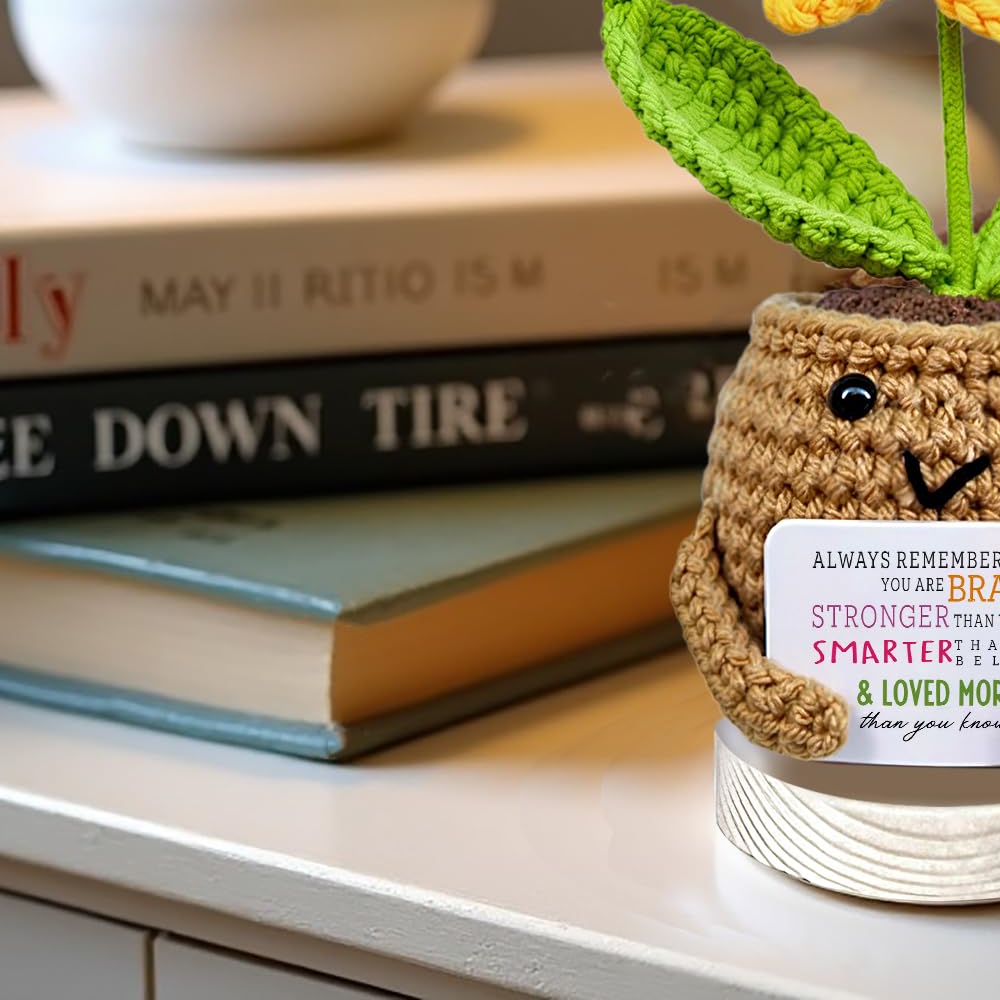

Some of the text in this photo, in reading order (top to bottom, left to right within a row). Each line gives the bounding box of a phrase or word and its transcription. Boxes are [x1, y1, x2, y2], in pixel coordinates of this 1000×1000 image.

[139, 276, 234, 318] MAY
[93, 394, 322, 472] DOWN
[360, 377, 528, 451] TIRE
[813, 551, 890, 569] ALWAYS
[881, 577, 911, 592] YOU
[915, 577, 944, 592] ARE
[811, 604, 949, 629] STRONGER
[953, 614, 994, 628] THAN
[813, 639, 953, 665] SMARTER
[857, 679, 873, 706] &
[882, 679, 950, 706] LOVED
[859, 712, 905, 730] than
[903, 717, 955, 742] you
